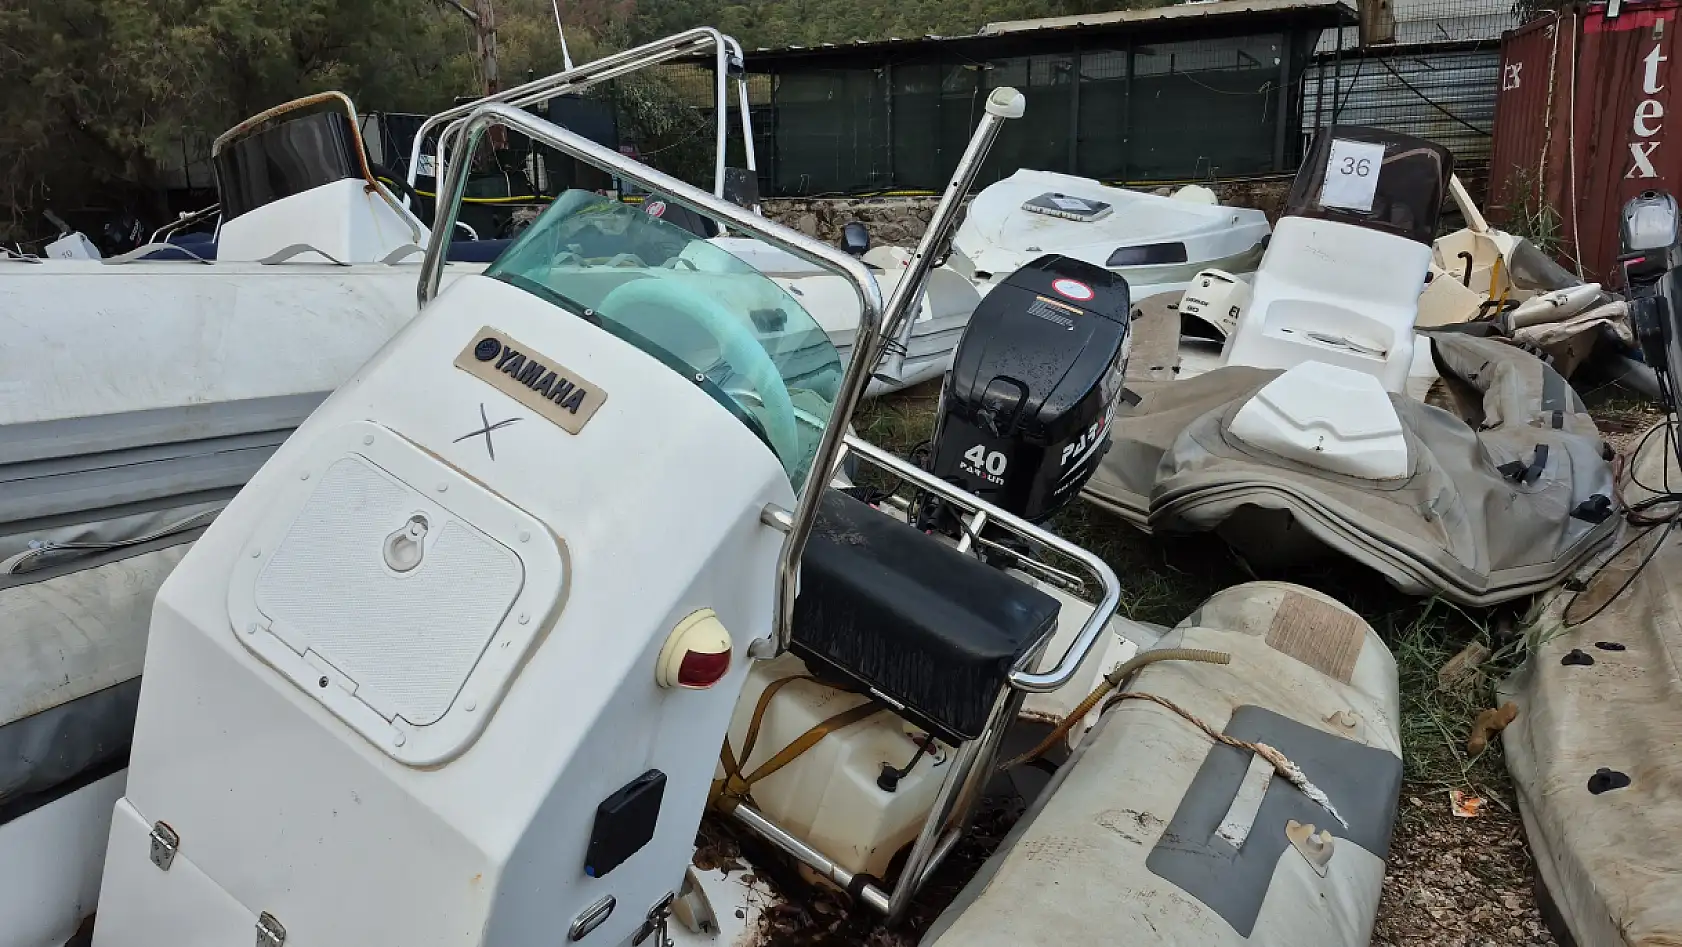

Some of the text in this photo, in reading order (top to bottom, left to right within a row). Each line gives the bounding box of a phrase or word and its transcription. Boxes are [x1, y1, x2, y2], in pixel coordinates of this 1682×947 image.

[1623, 43, 1668, 179] tex
[1340, 156, 1371, 178] 36
[494, 345, 587, 415] YAMAHA
[964, 443, 1008, 476] 40
